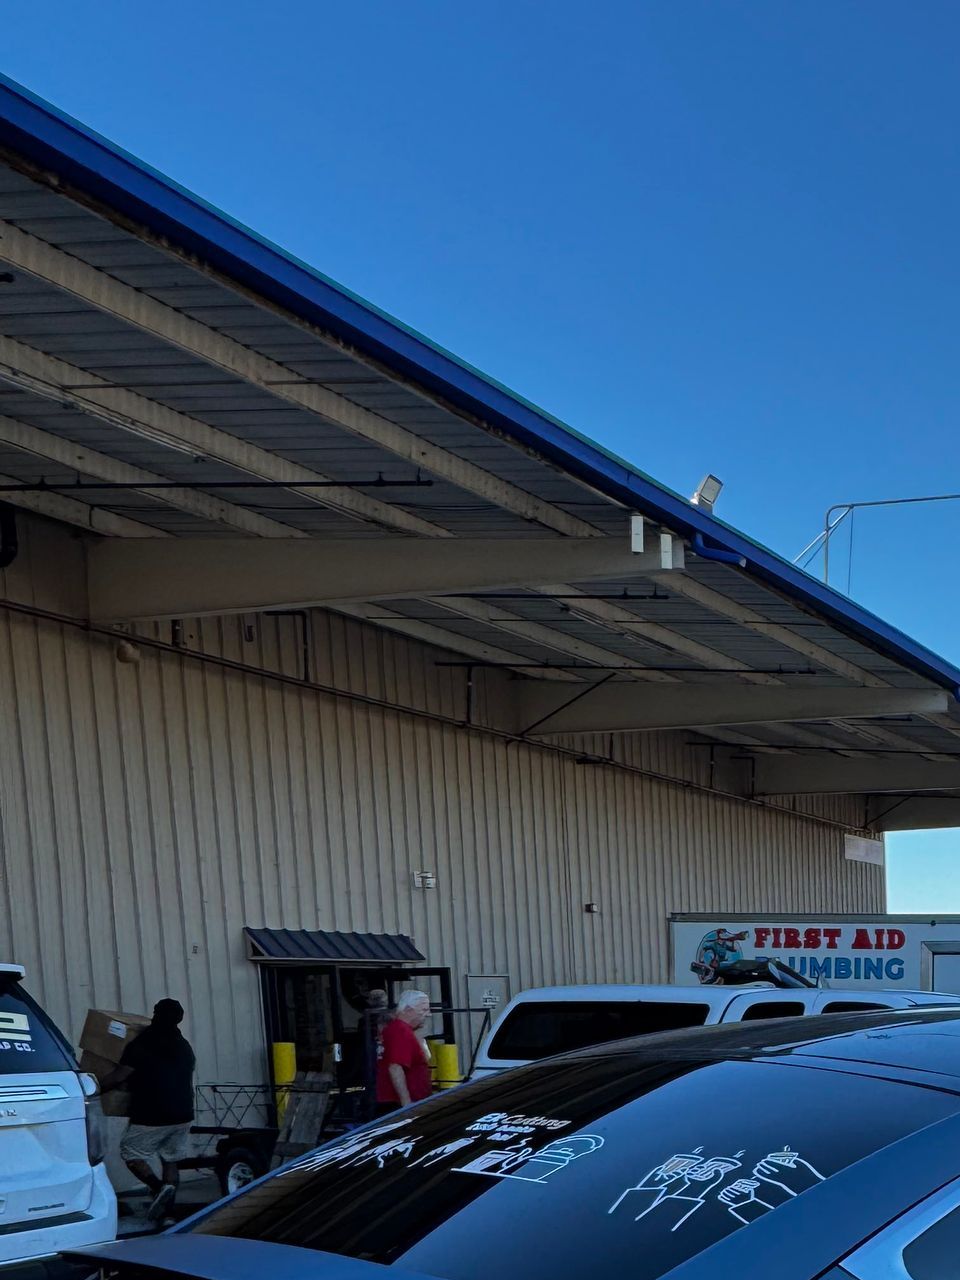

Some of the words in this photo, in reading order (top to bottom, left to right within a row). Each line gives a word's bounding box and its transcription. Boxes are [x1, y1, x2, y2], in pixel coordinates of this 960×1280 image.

[754, 927, 842, 949] FIRST
[851, 928, 906, 950] AID
[501, 1114, 572, 1130] Cutting
